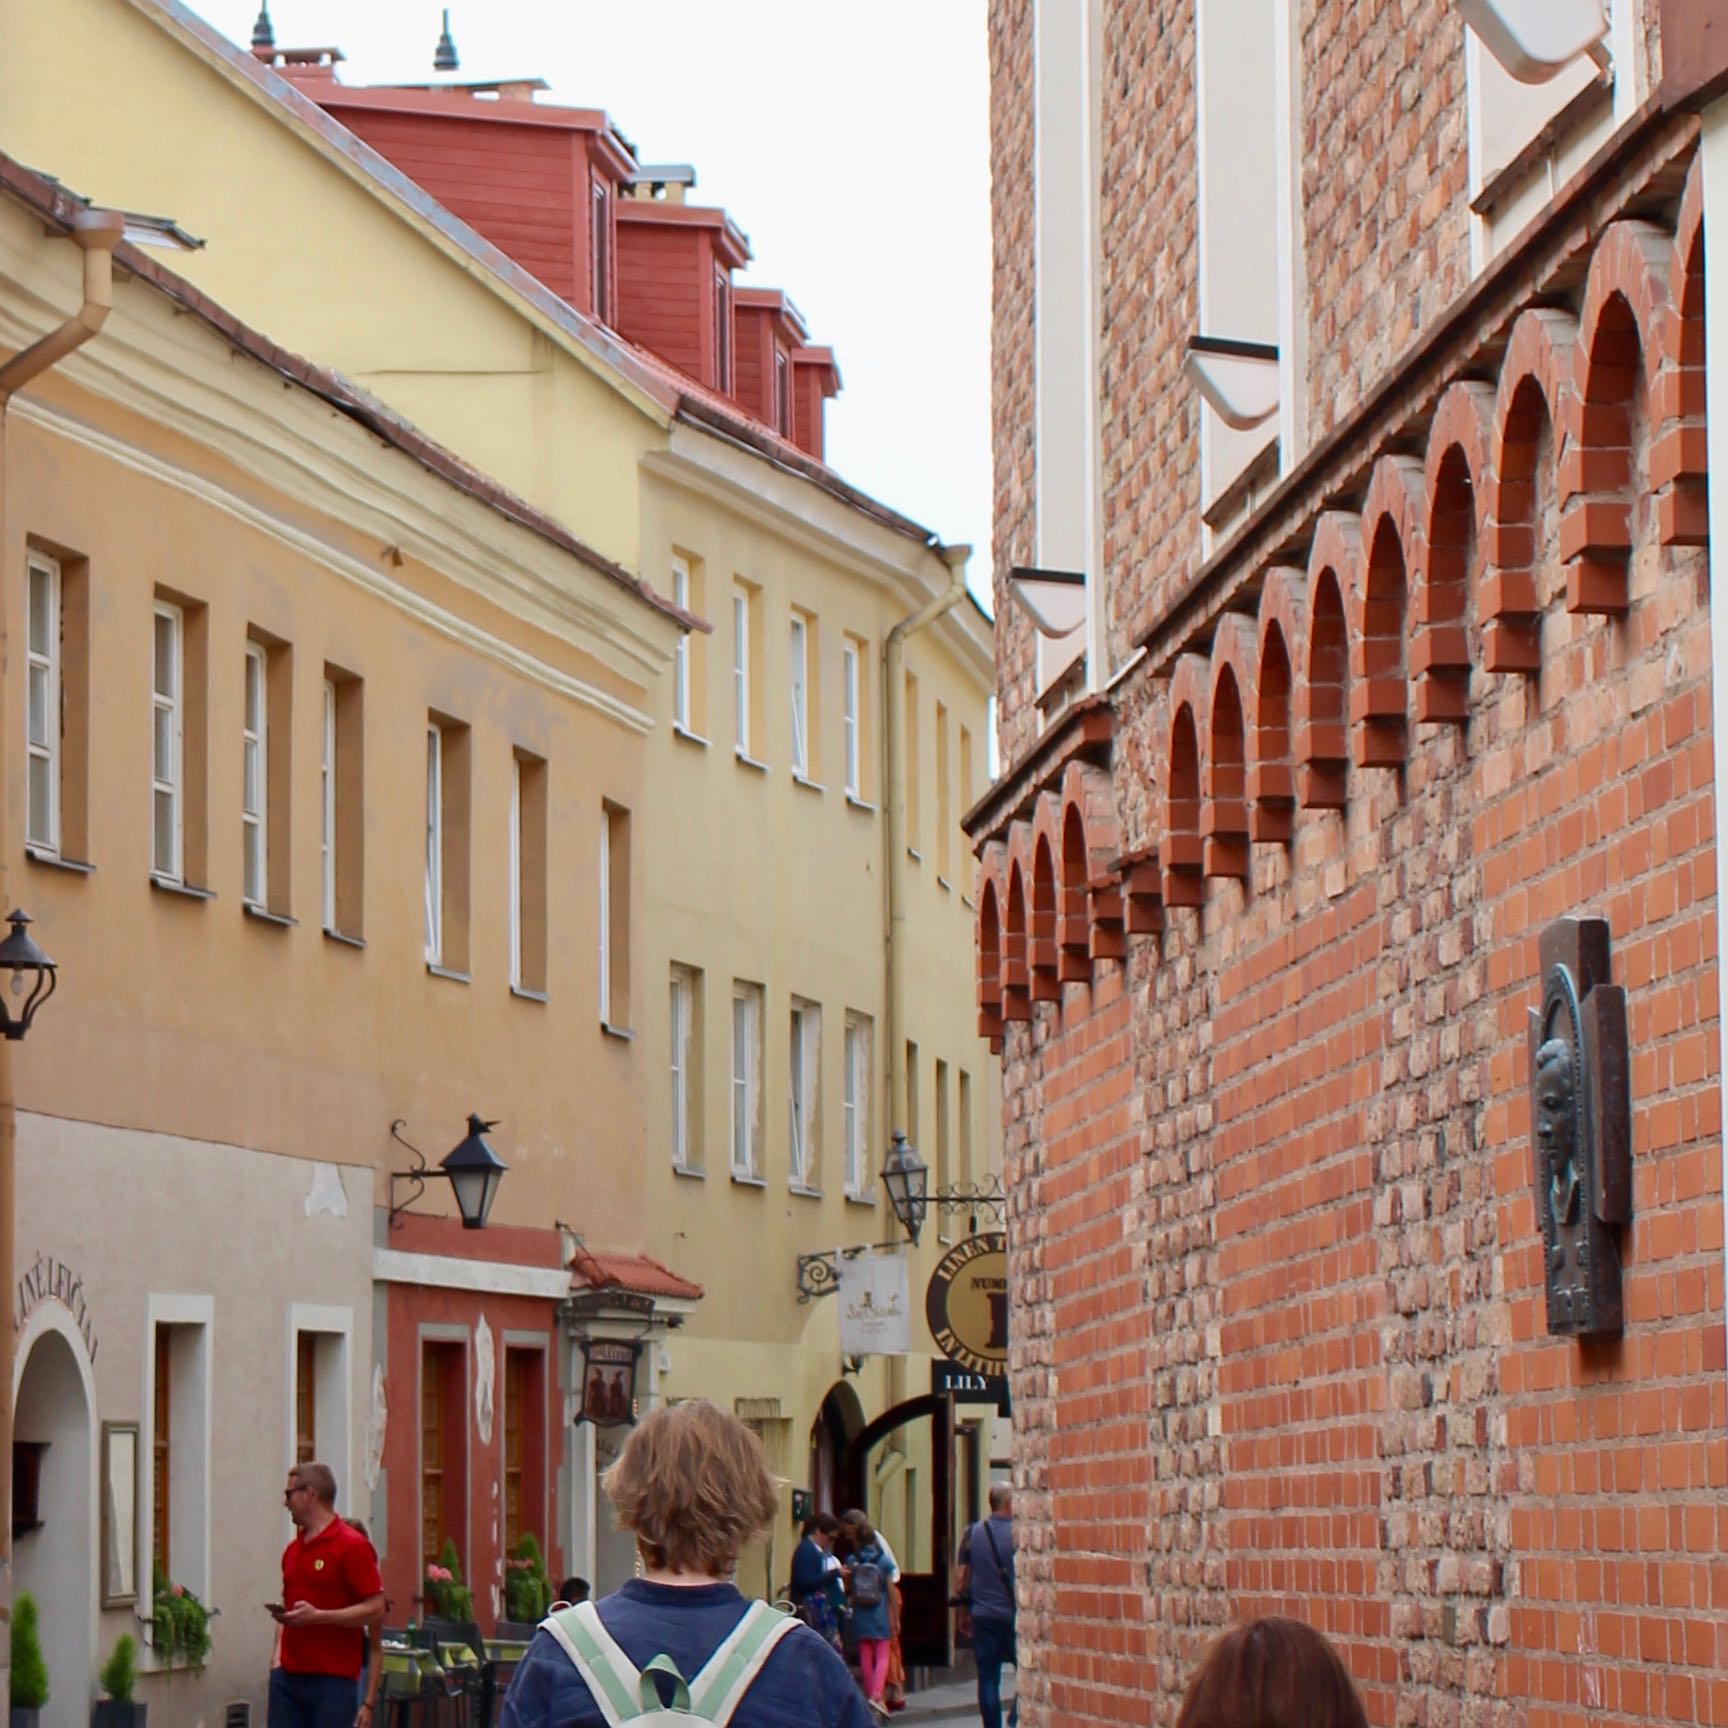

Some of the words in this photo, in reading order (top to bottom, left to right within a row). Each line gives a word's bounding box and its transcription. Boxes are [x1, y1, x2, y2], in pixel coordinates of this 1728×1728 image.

[937, 1238, 991, 1282] LINEN
[971, 1278, 1008, 1290] NUM
[945, 1375, 989, 1390] LILY
